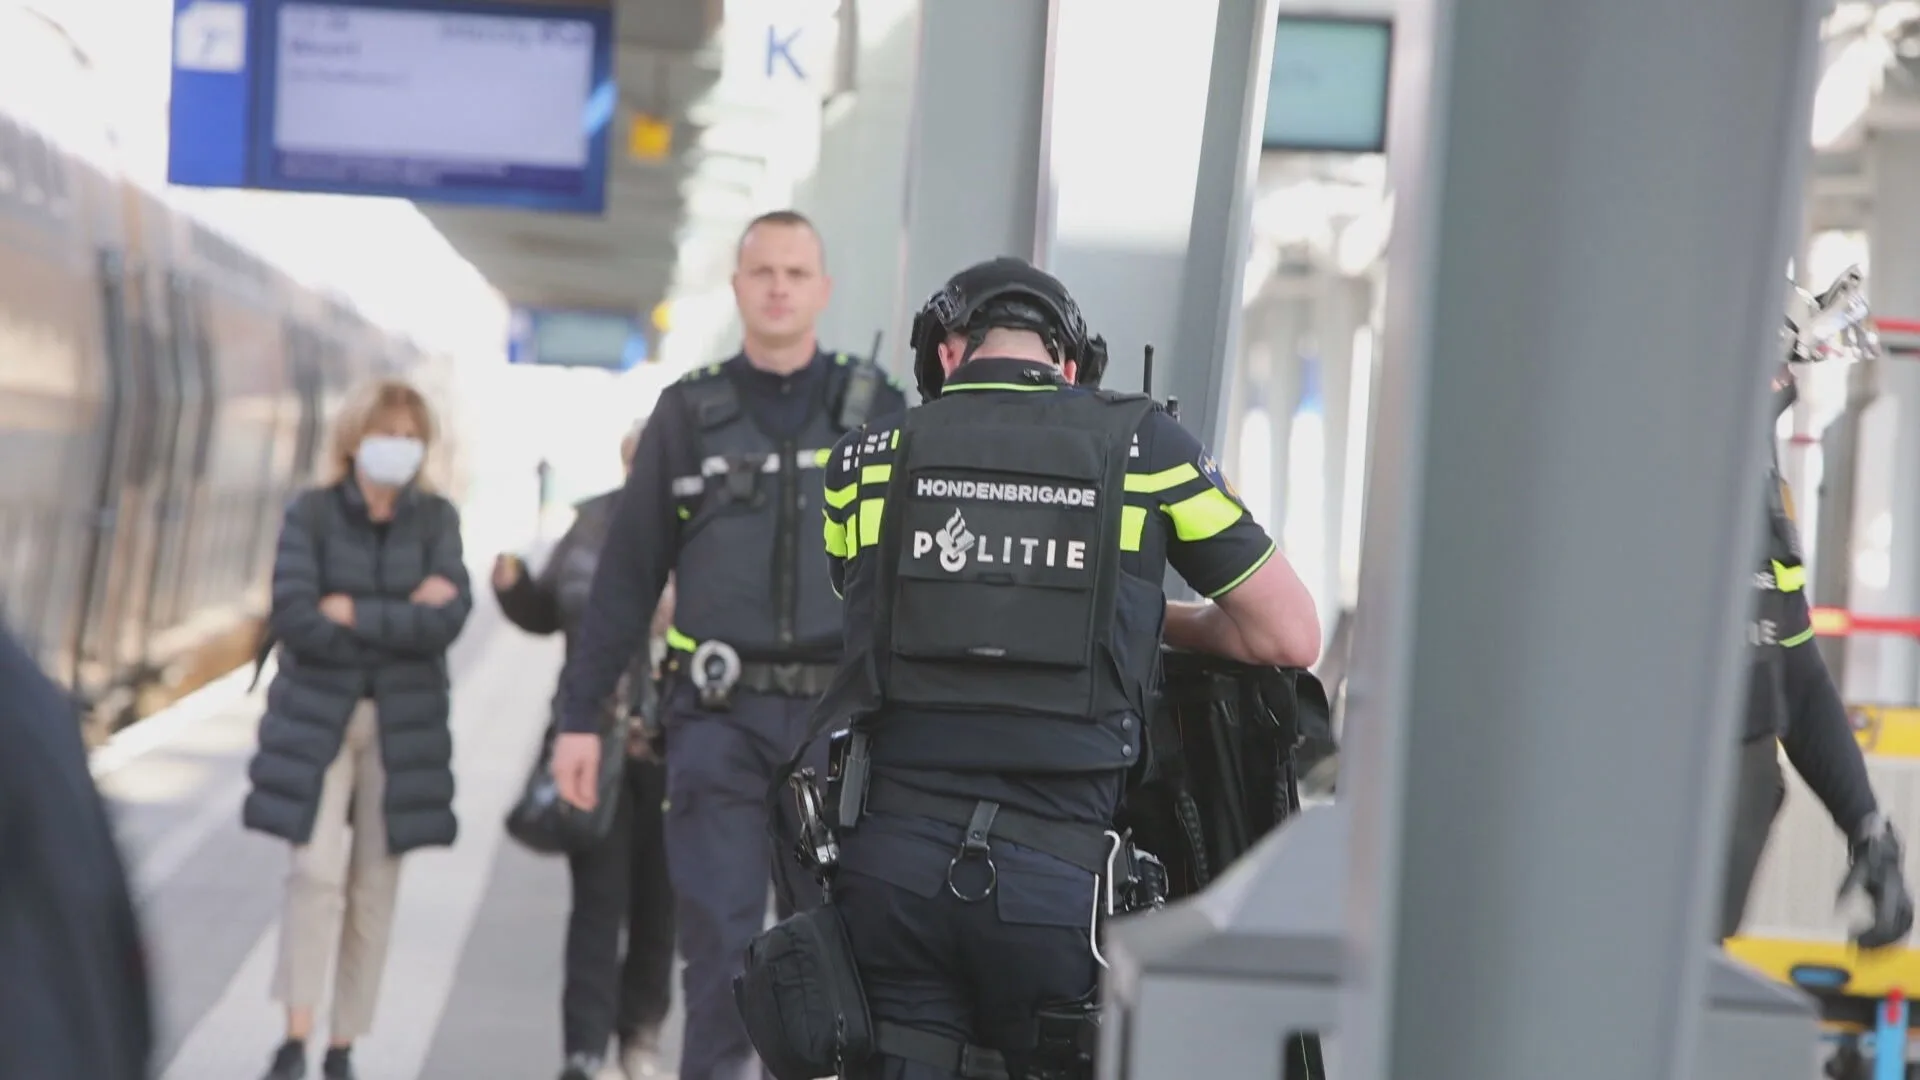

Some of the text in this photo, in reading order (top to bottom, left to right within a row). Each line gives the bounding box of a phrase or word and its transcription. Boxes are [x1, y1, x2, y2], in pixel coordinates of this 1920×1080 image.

[766, 24, 806, 79] K
[917, 478, 1096, 506] HONDENBRIGADE
[913, 527, 1086, 572] POLITIE
